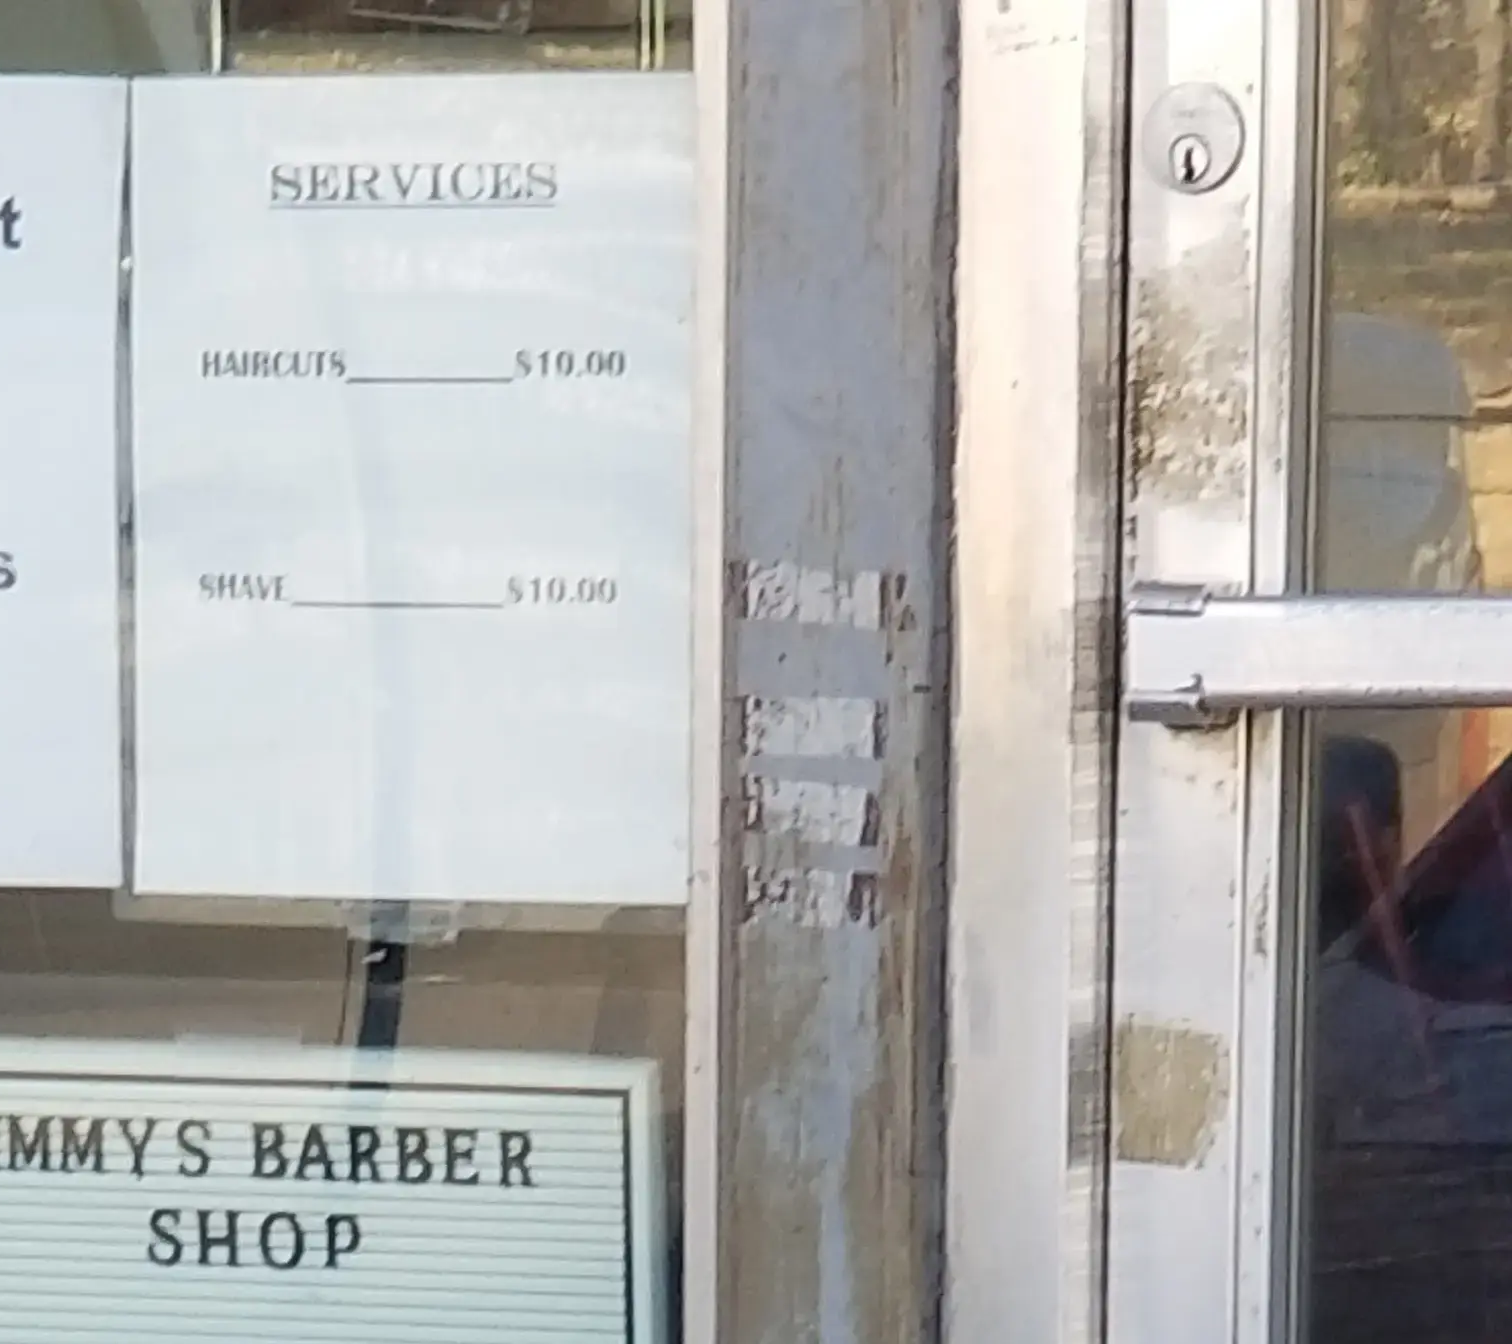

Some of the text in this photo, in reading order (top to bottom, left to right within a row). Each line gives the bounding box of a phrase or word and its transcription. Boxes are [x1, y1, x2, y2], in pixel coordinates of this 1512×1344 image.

[270, 163, 558, 203] SERVICES
[201, 350, 626, 378] HAIRCUTS $10.00
[199, 574, 617, 604] SHAVE $10.00
[250, 1122, 536, 1187] BARBER
[147, 1209, 362, 1269] SHOP
